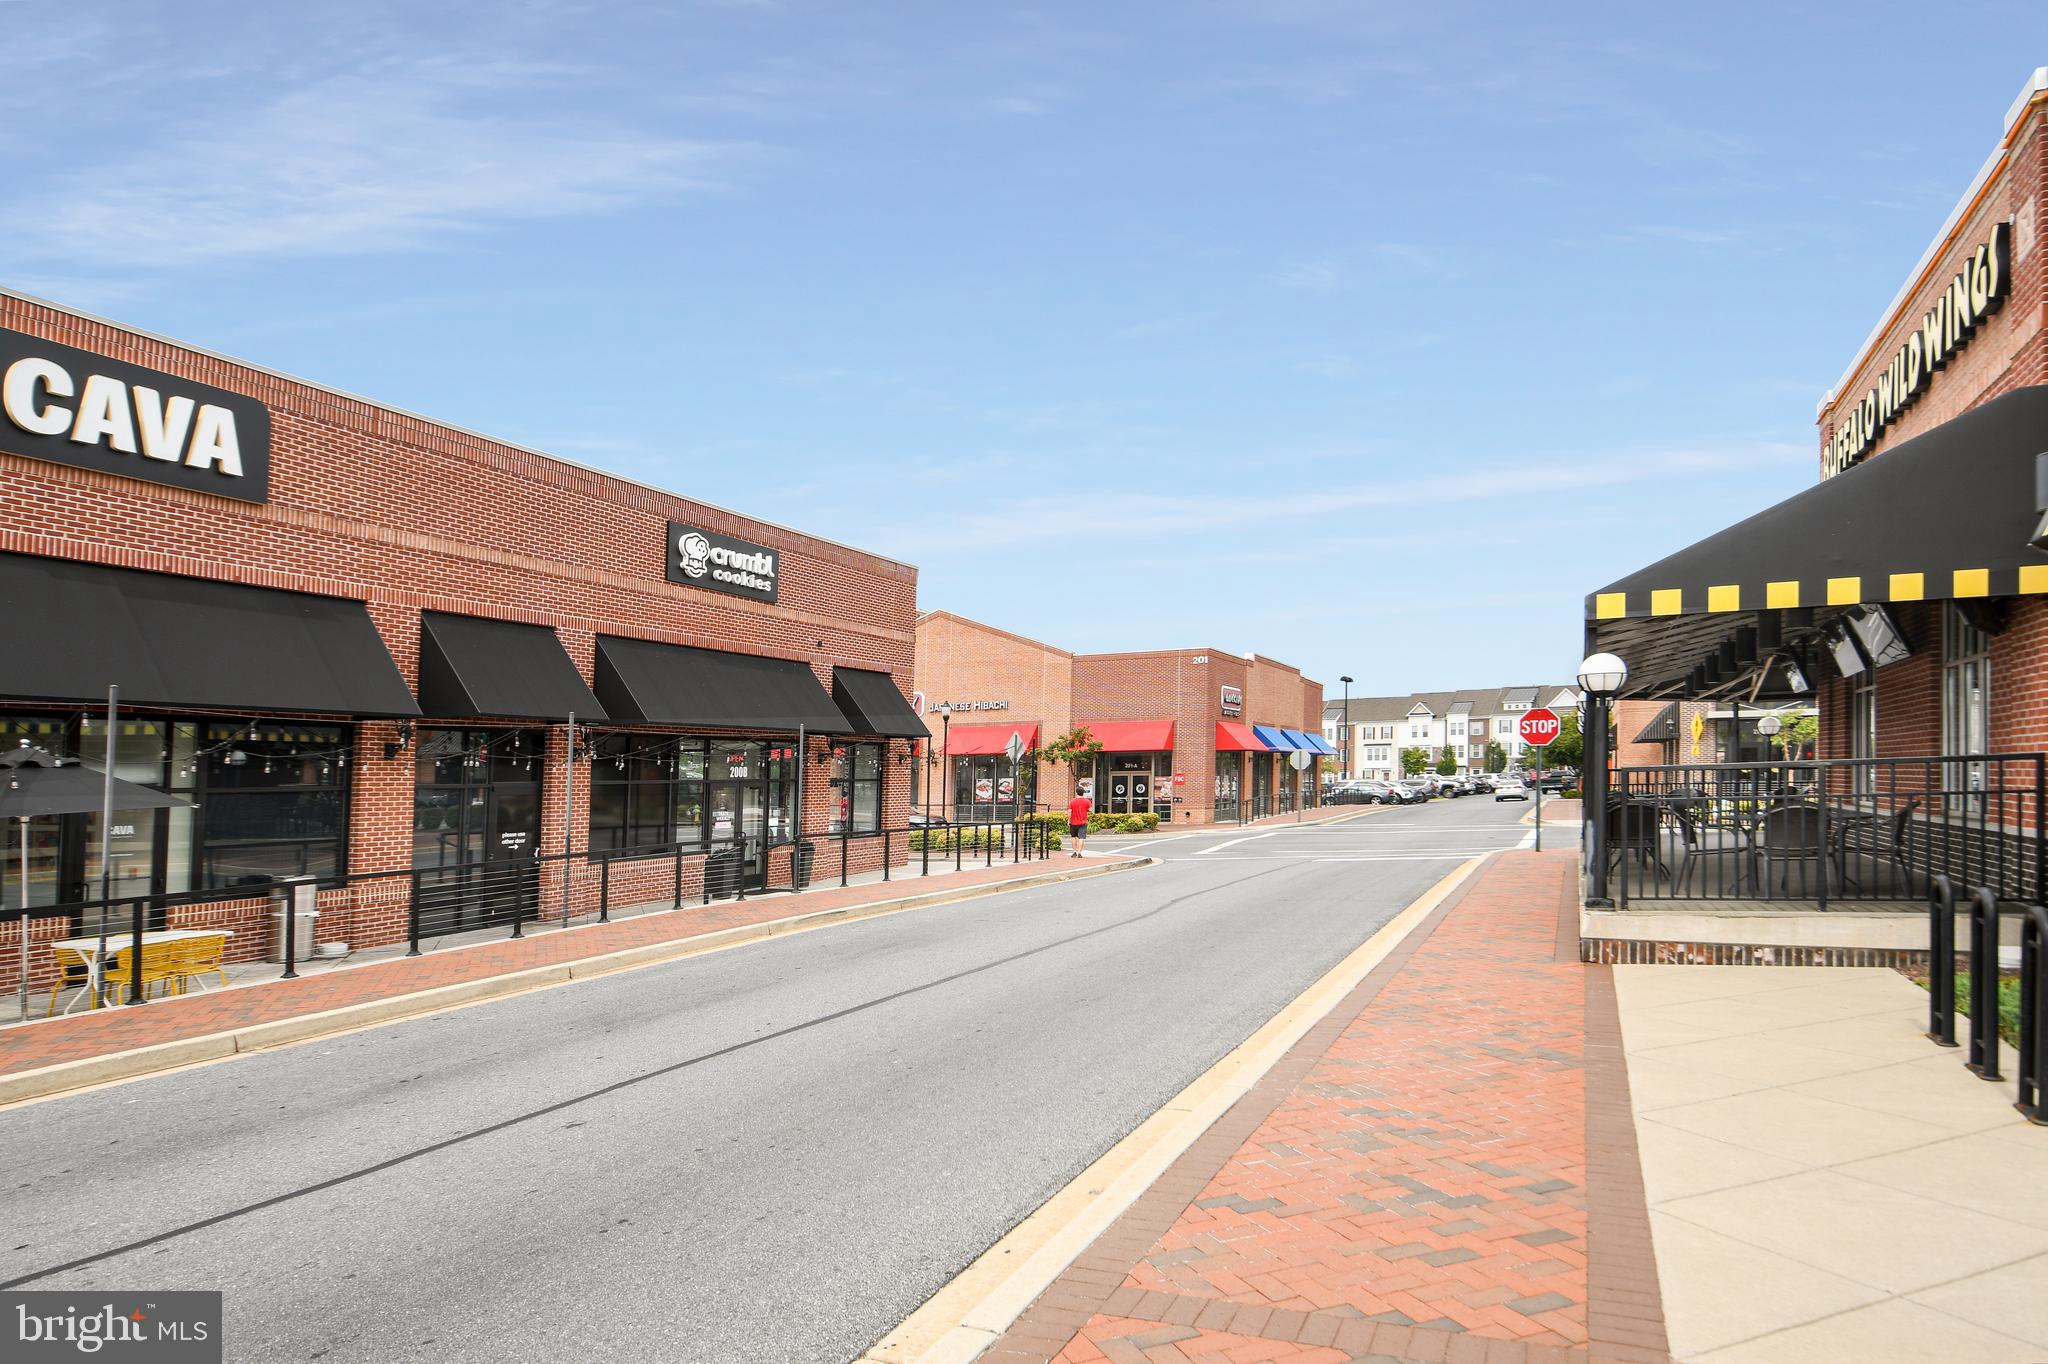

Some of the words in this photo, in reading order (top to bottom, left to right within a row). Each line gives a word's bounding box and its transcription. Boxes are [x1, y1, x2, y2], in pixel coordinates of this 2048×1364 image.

[1823, 388, 1877, 481] BUFFALO
[1878, 330, 1923, 427] WILD
[1922, 223, 2003, 374] WINGS
[3, 357, 244, 477] CAVA
[710, 546, 775, 578] crumbl
[713, 569, 772, 592] cookies
[1192, 656, 1209, 665] 201
[973, 700, 1009, 711] HIBACHI
[1521, 719, 1558, 734] STOP
[730, 766, 748, 778] 200B
